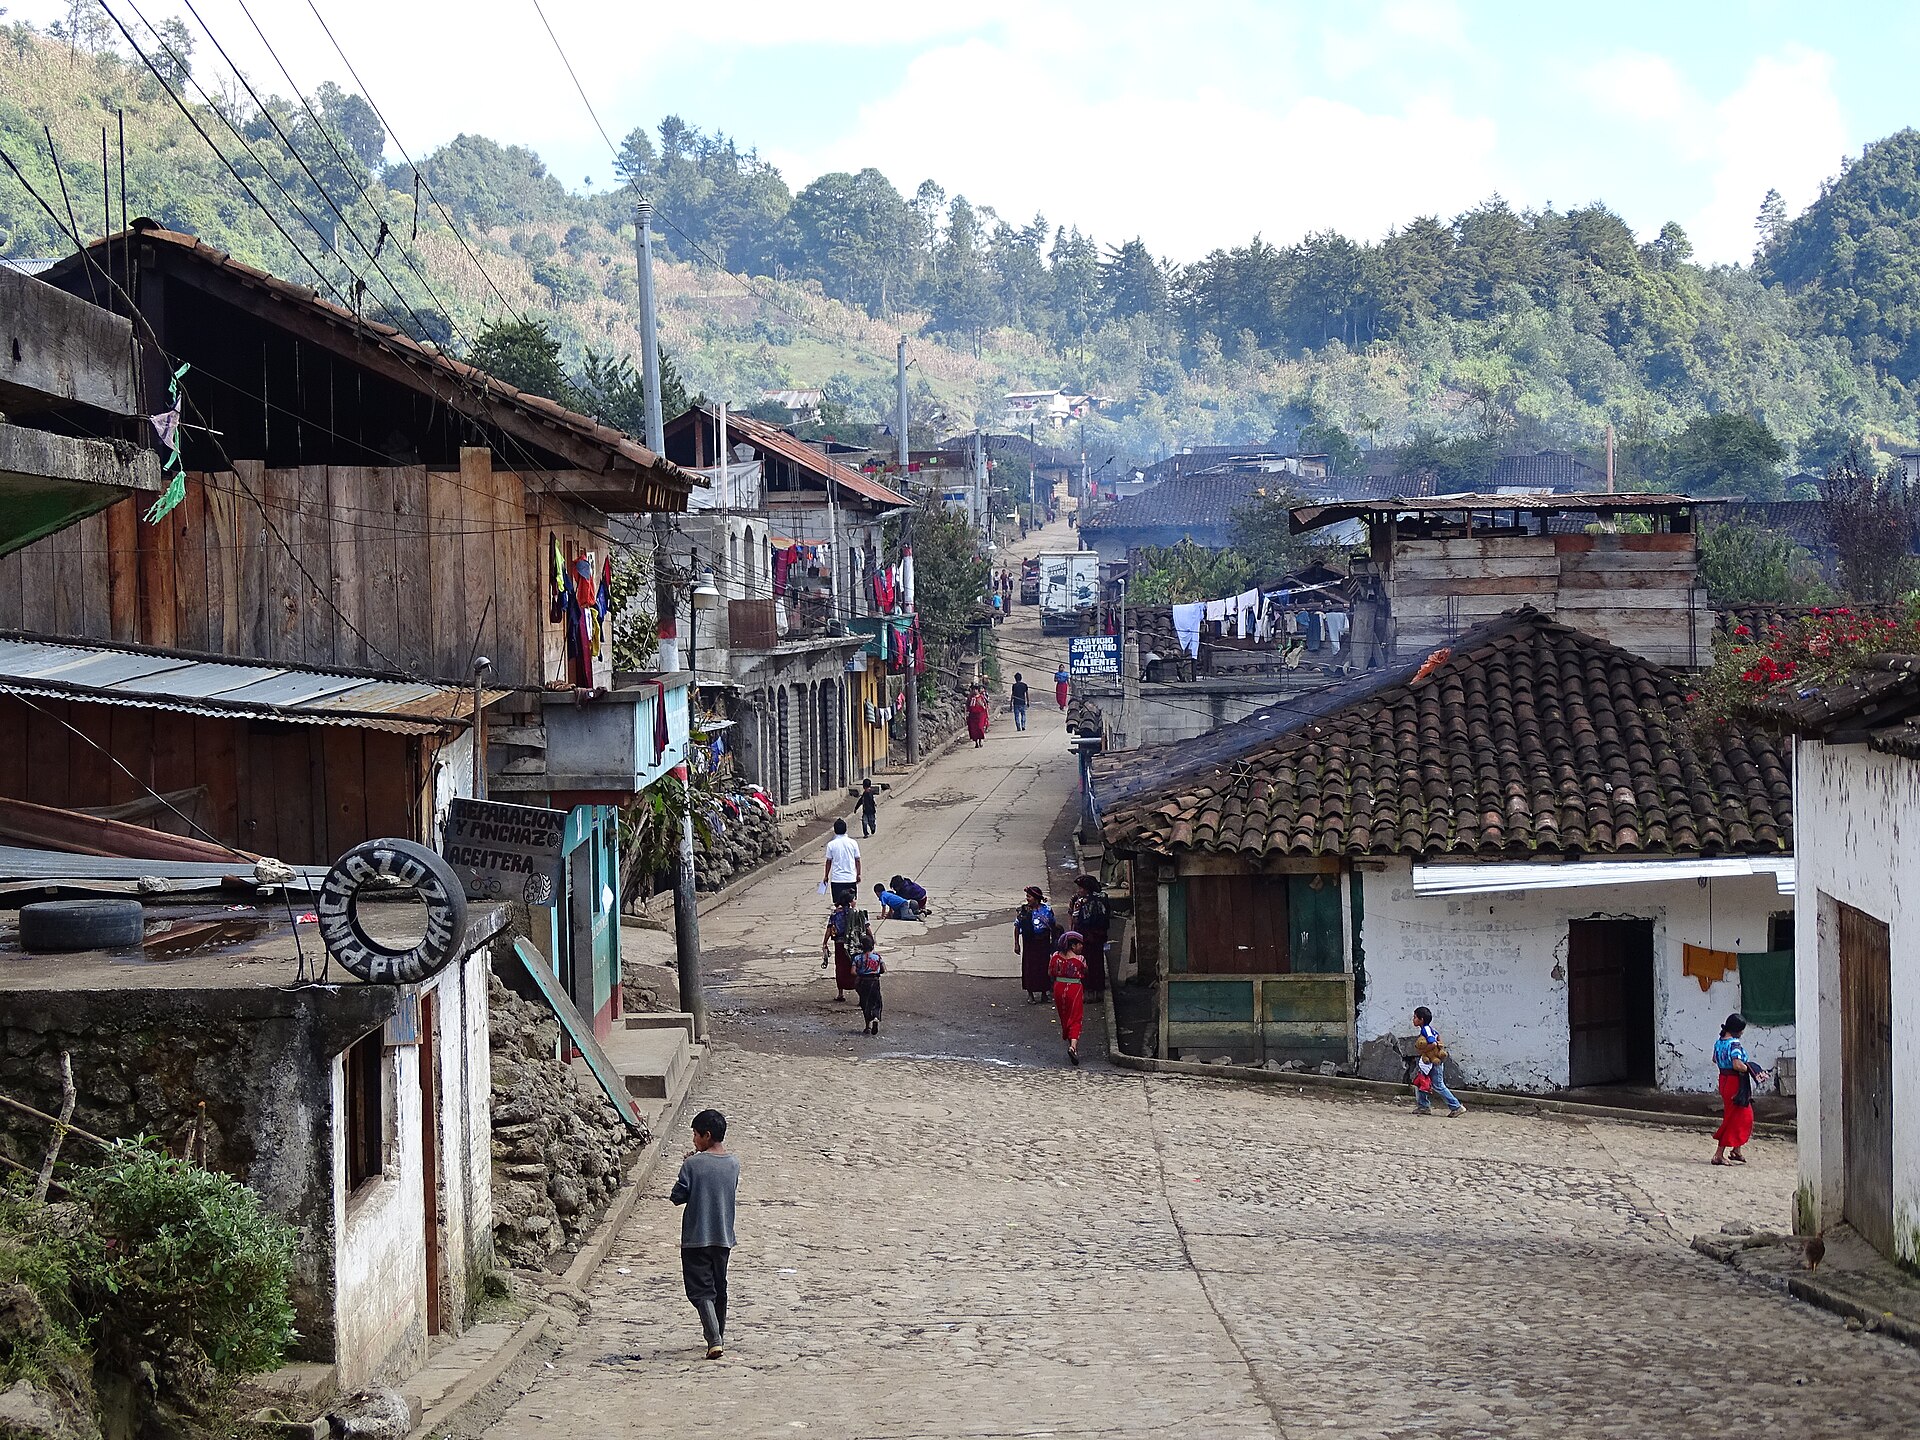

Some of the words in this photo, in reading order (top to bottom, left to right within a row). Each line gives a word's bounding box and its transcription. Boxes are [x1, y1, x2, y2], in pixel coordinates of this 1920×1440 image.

[1071, 644, 1117, 653] SANITARIO
[1073, 637, 1114, 646] SERVICIO
[1073, 658, 1117, 667] CALIENTE
[456, 801, 565, 831] REPARACION
[456, 820, 468, 836] Y
[449, 846, 534, 875] ACEITERA
[319, 849, 426, 968] PINCHAZO
